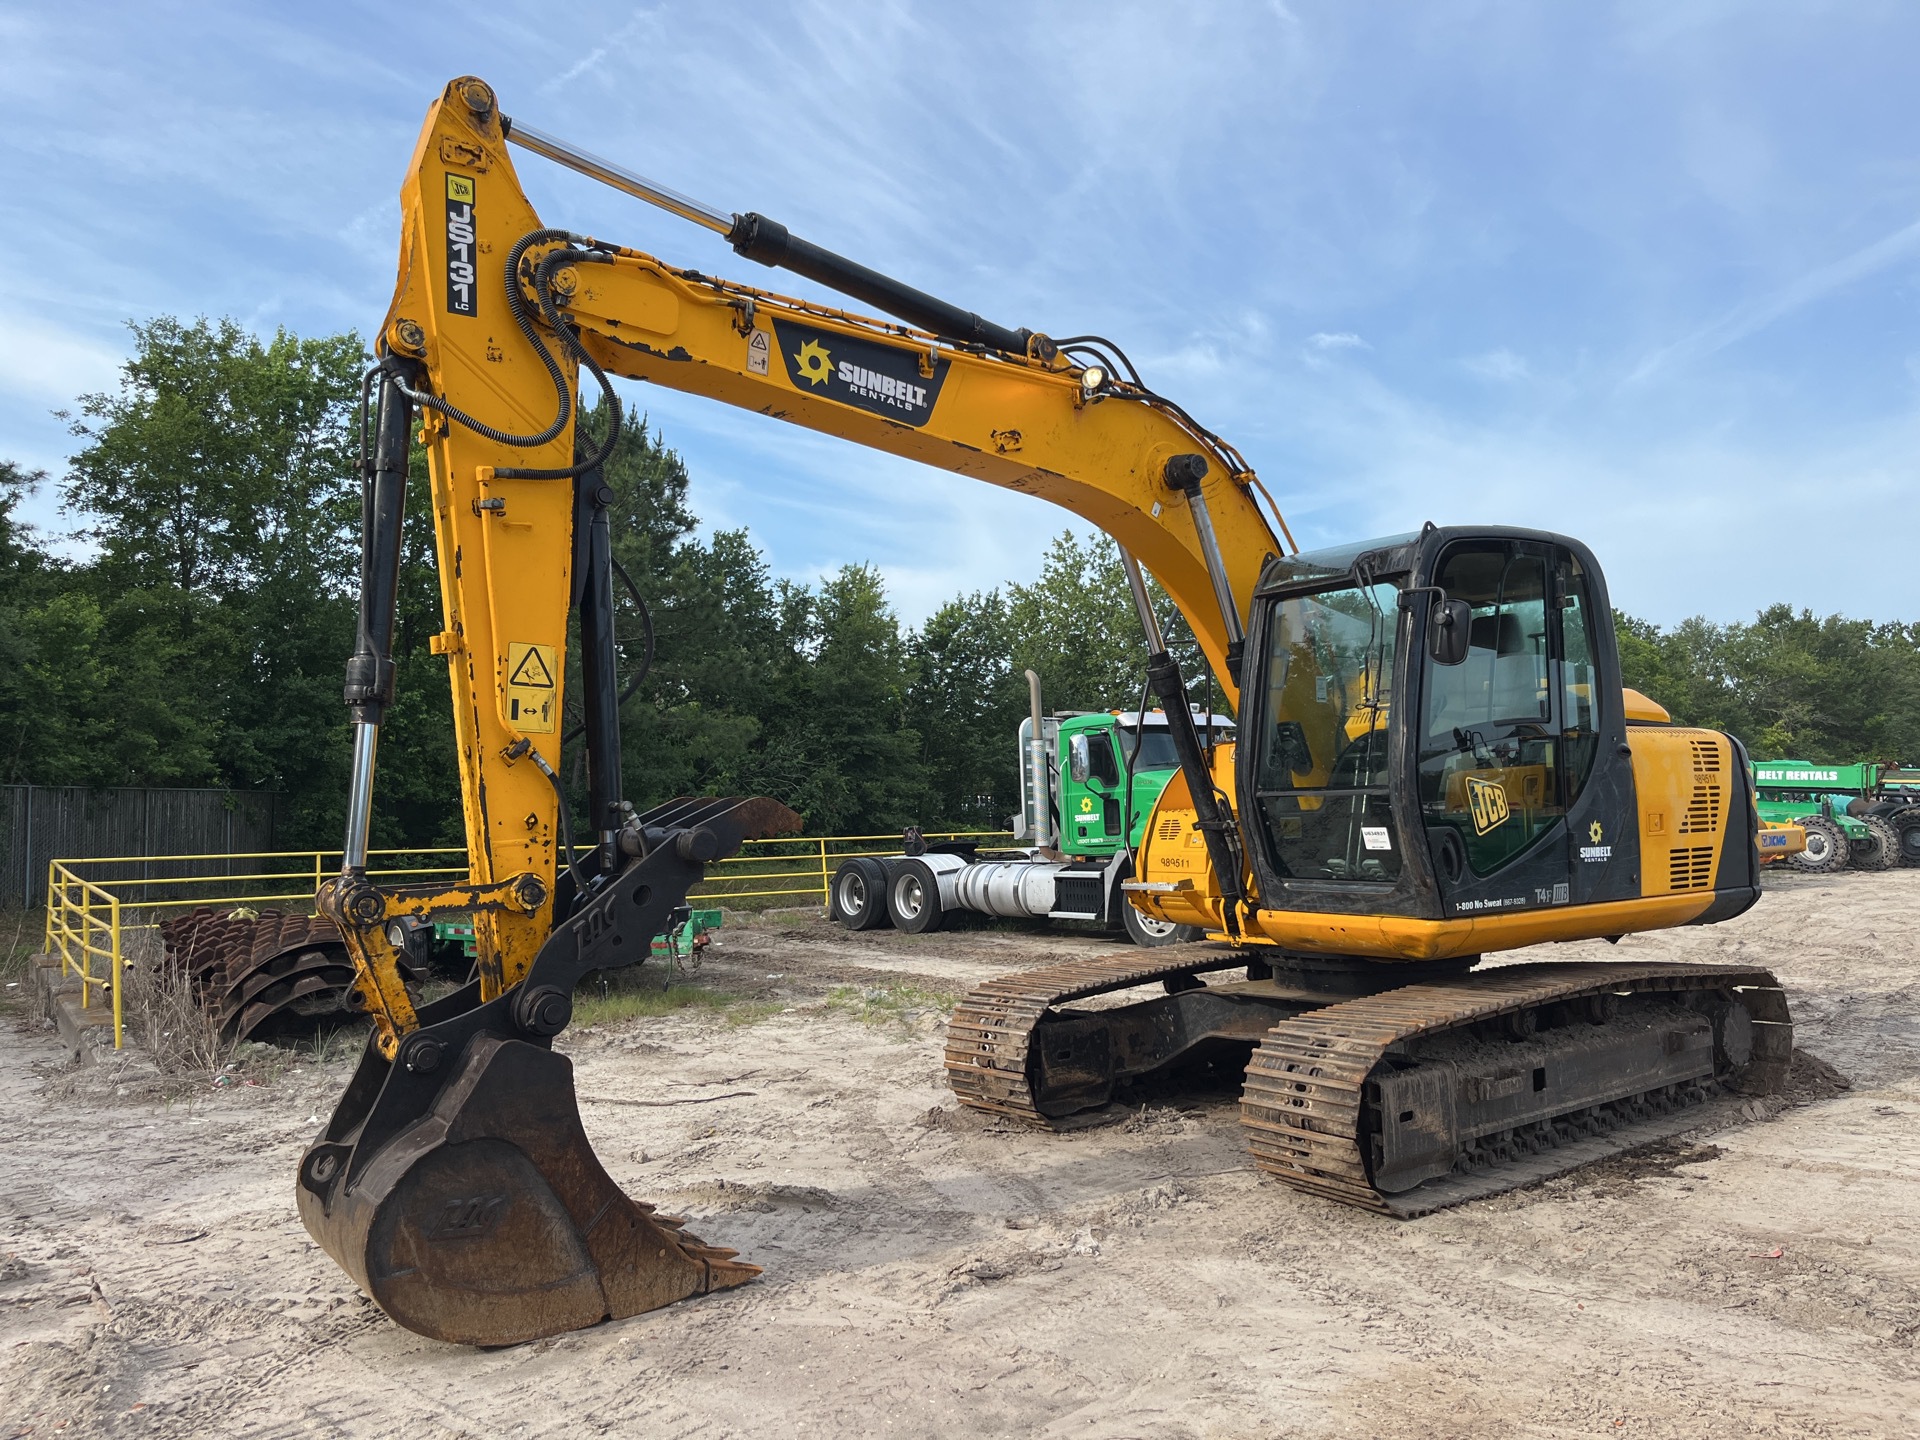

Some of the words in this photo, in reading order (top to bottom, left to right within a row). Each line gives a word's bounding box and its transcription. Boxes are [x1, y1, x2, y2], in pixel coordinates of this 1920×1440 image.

[454, 182, 470, 195] JCB
[448, 204, 474, 304] JS131
[455, 302, 470, 311] LC
[838, 361, 926, 407] SUNBELT
[850, 384, 913, 411] RENTALS
[1757, 770, 1784, 780] BELT
[1786, 770, 1838, 781] RENTALS
[1474, 783, 1507, 829] JCB
[1074, 813, 1100, 822] SUNBELT
[1580, 846, 1612, 859] SUNBELT
[1160, 857, 1190, 868] 989511
[1535, 888, 1552, 904] T4F
[1455, 901, 1474, 911] 1-800
[1474, 900, 1483, 909] No
[1484, 899, 1503, 908] Sweat
